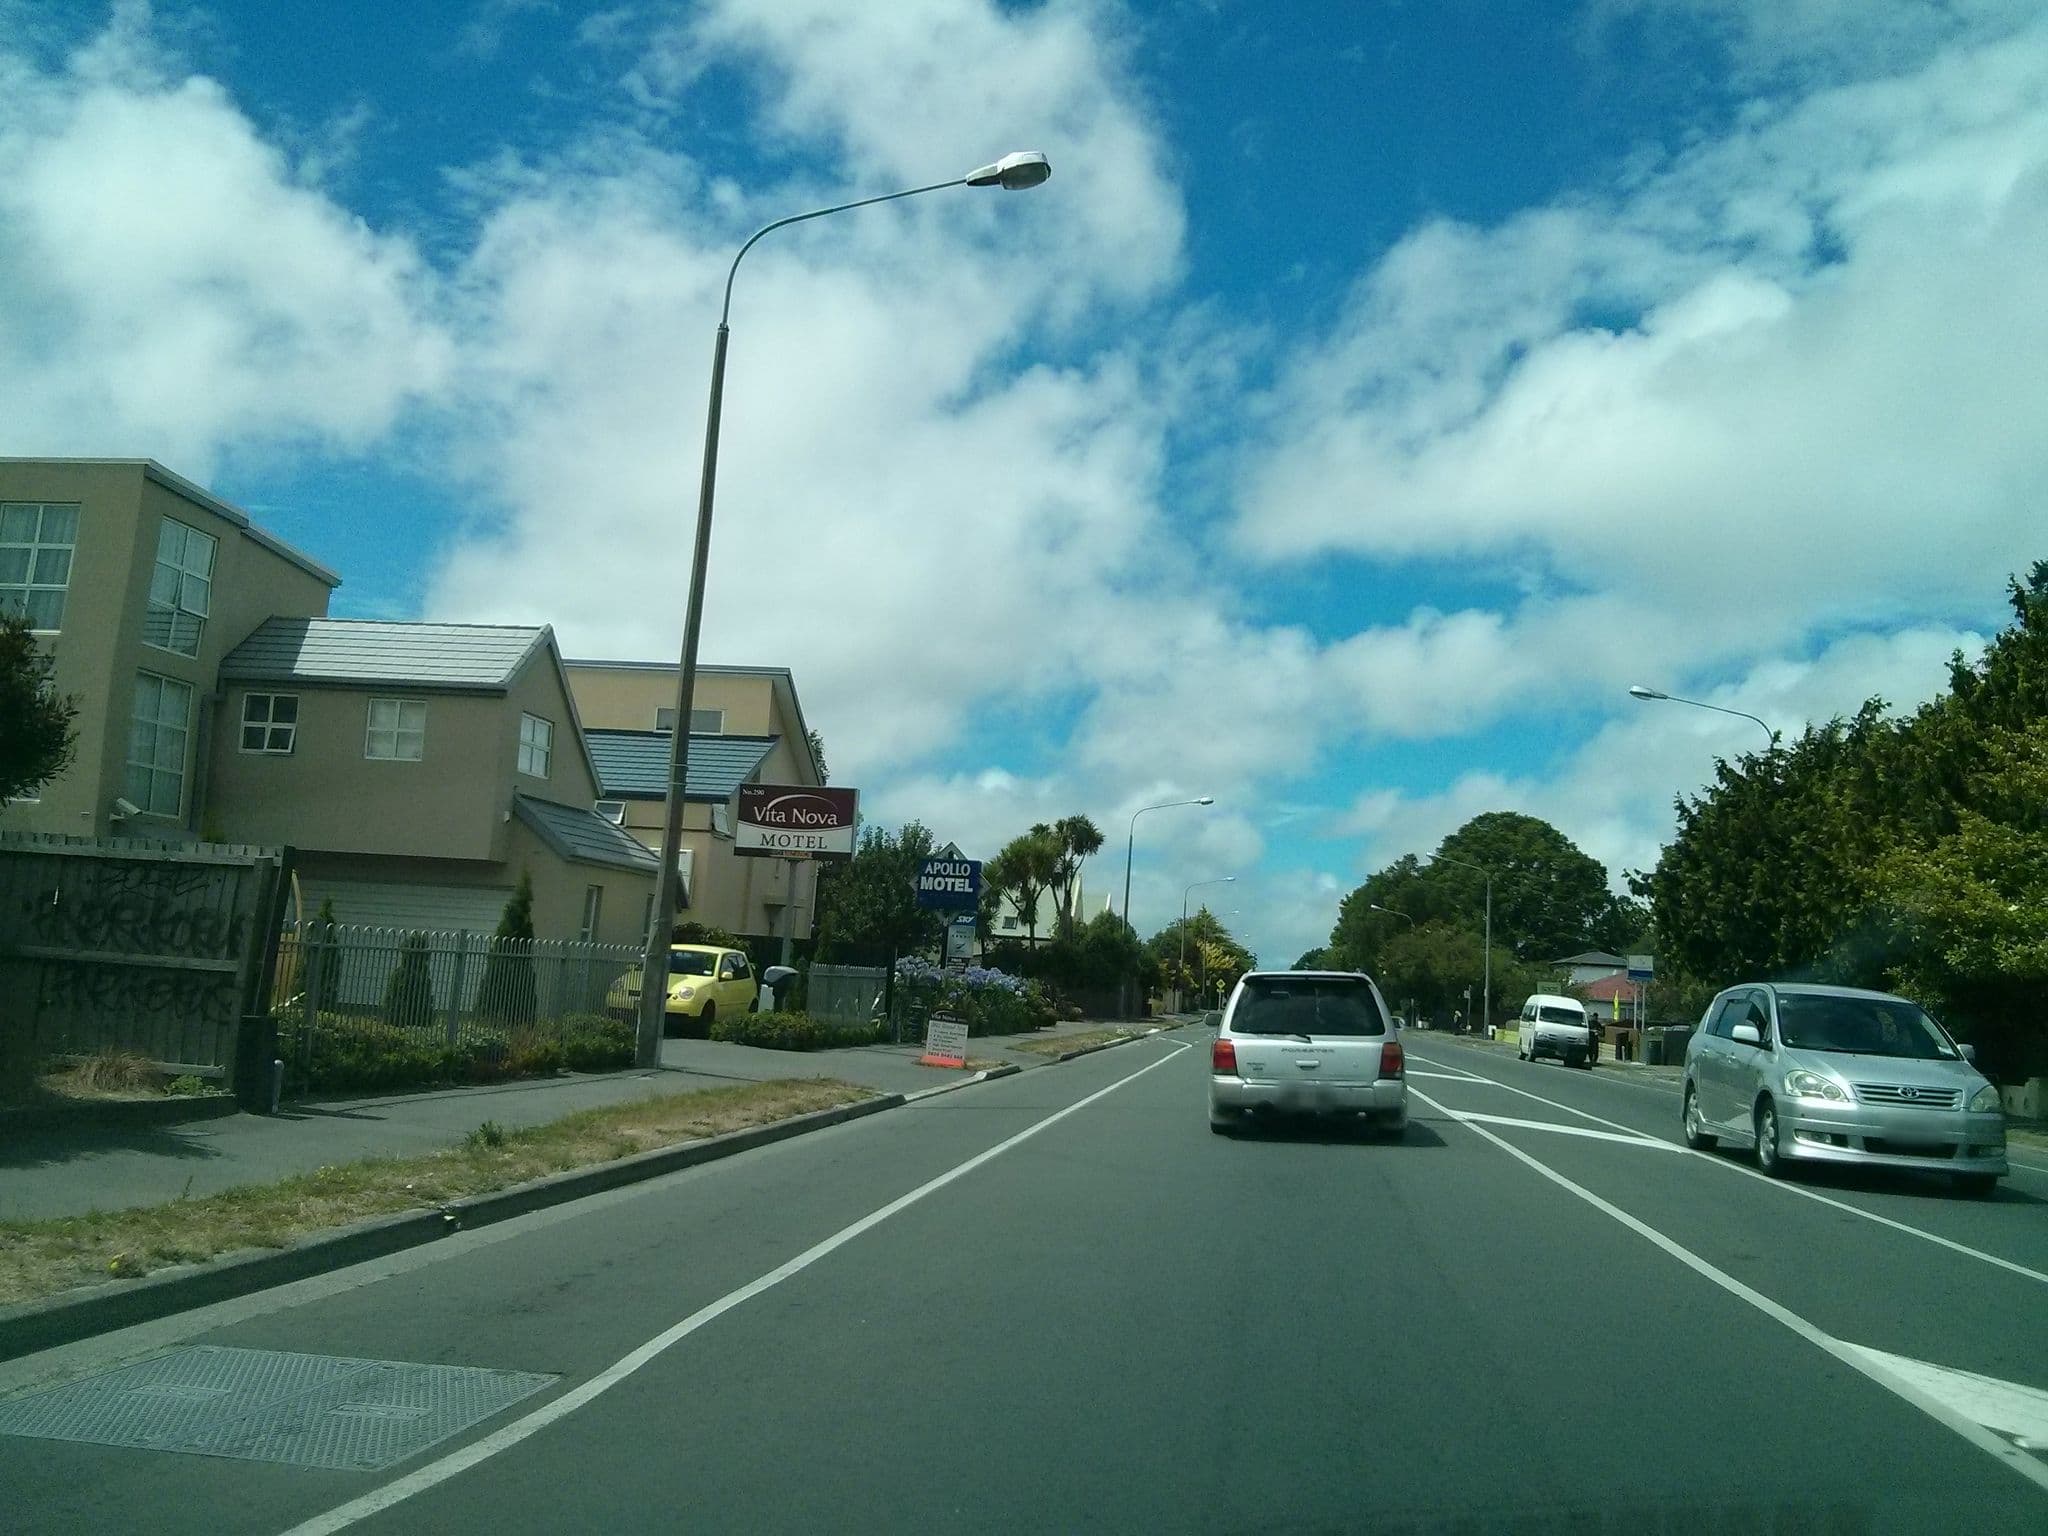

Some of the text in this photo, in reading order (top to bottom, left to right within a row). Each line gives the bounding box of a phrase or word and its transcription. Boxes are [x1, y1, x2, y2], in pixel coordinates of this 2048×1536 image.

[754, 806, 838, 825] Vita Nova
[760, 833, 828, 849] MOTEL
[925, 862, 971, 876] APOLLO
[920, 876, 974, 892] MOTEL
